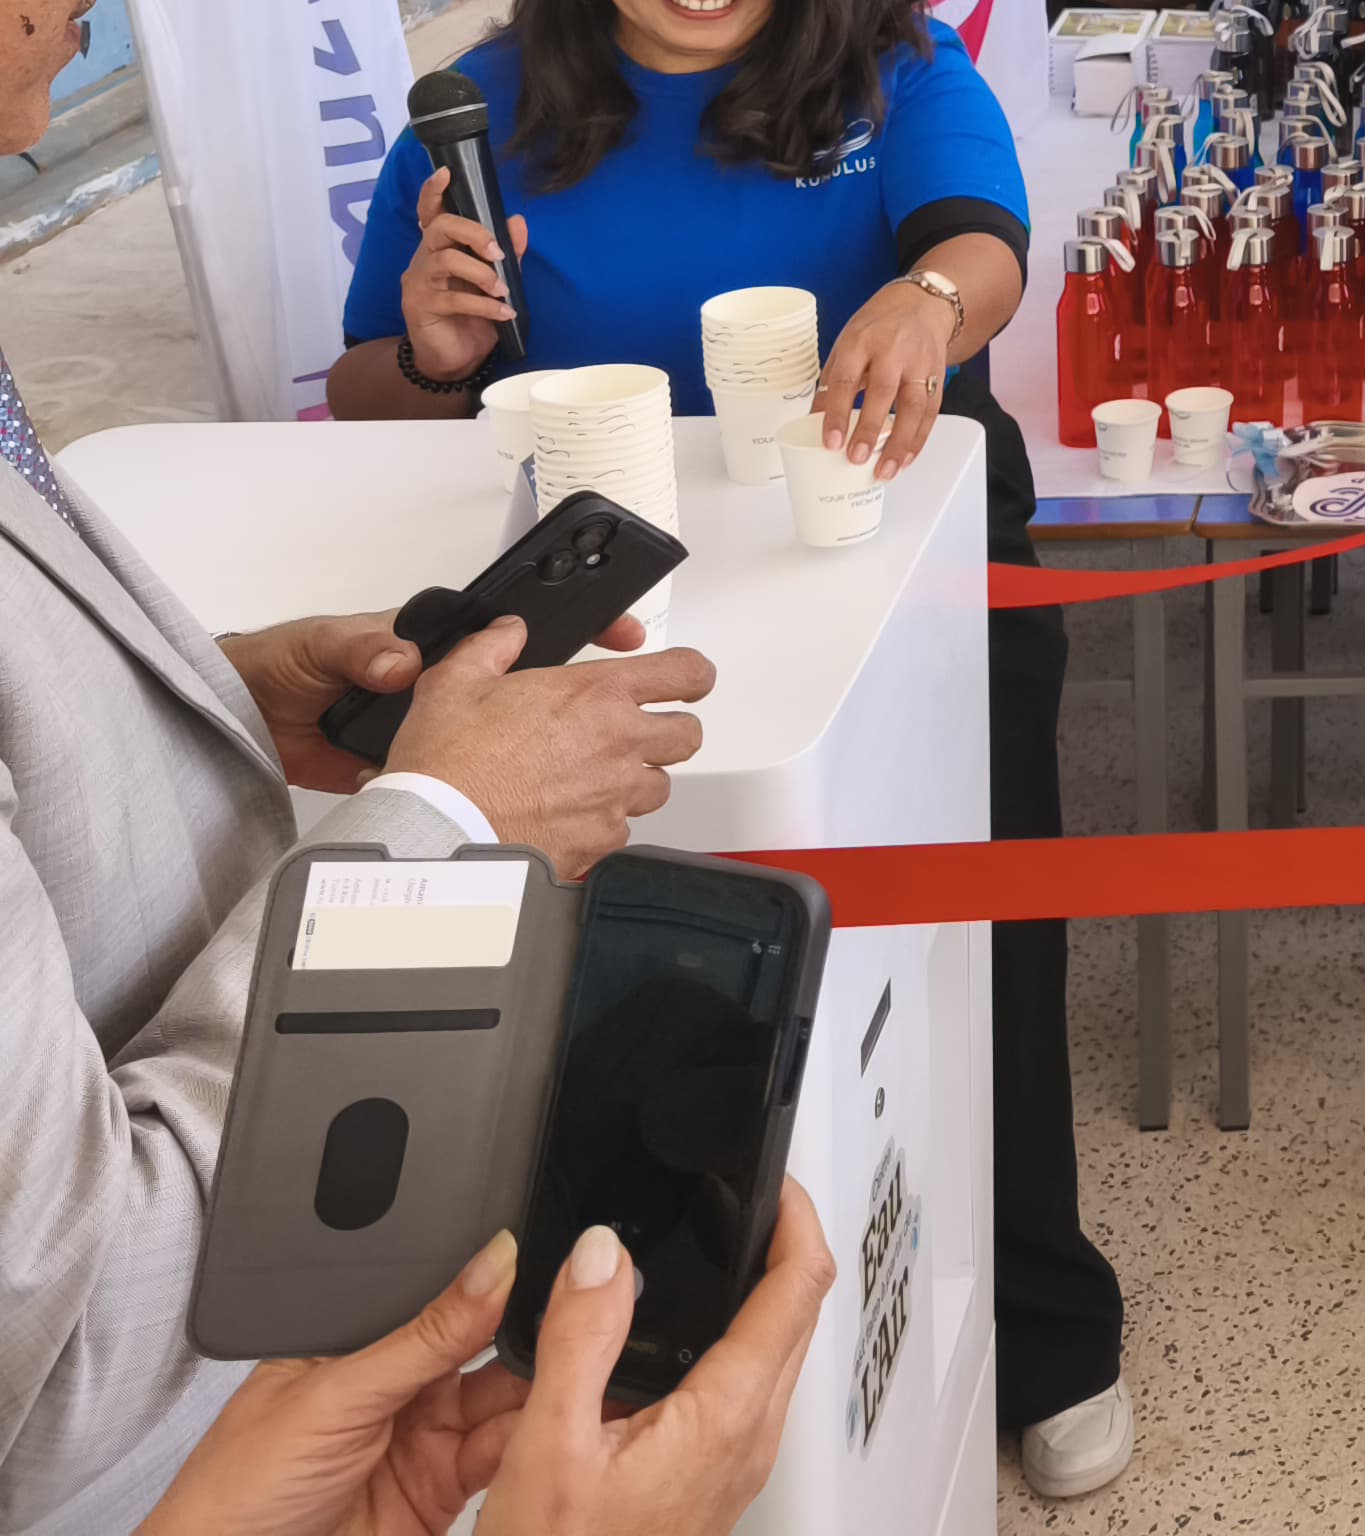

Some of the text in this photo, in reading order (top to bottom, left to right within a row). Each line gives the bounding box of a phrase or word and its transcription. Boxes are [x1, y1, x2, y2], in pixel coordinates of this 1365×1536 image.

[795, 156, 876, 189] KUULUS
[863, 1161, 902, 1312] Eau
[861, 1265, 909, 1448] L'Air
